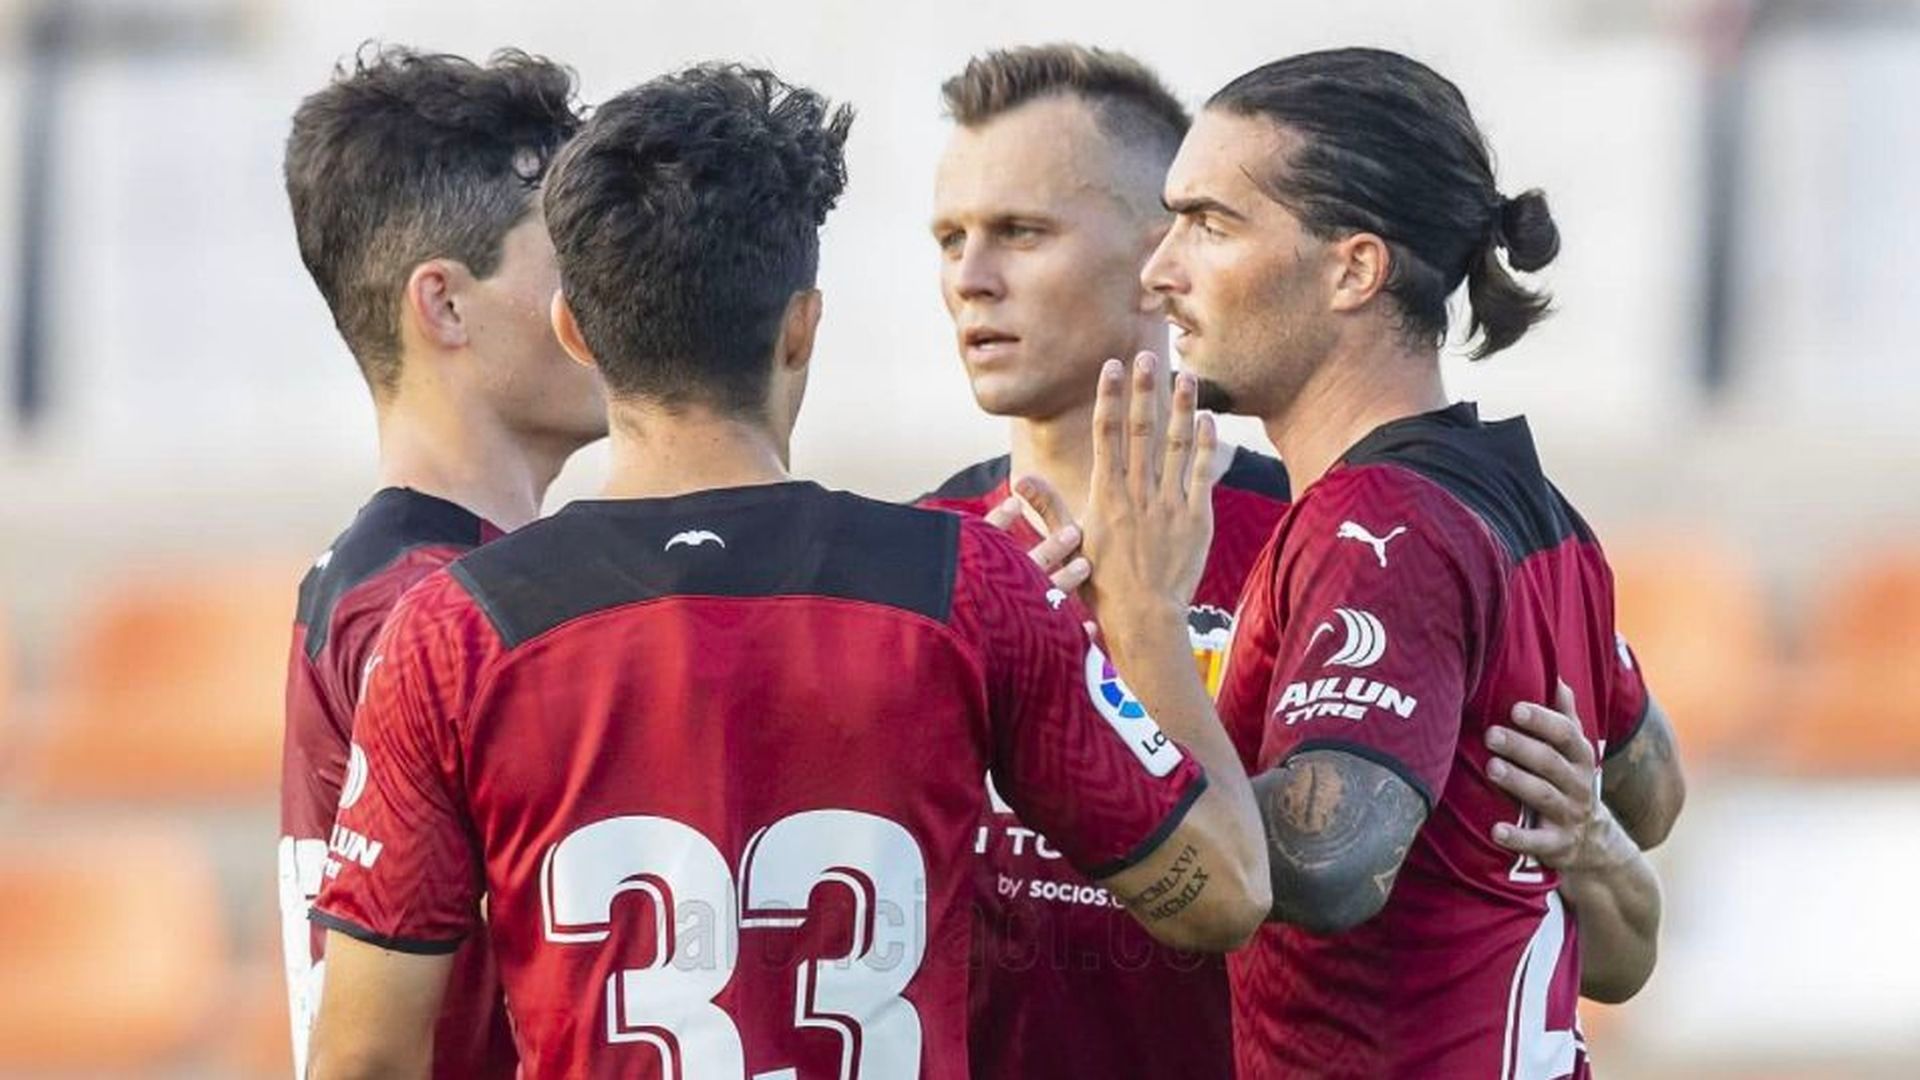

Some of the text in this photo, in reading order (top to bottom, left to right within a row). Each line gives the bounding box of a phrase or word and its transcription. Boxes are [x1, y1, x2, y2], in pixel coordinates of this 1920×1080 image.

[1273, 676, 1418, 719] AILUN
[1284, 702, 1368, 725] TYRE
[328, 824, 385, 869] LUN
[997, 870, 1024, 899] by
[539, 807, 927, 1080] 33
